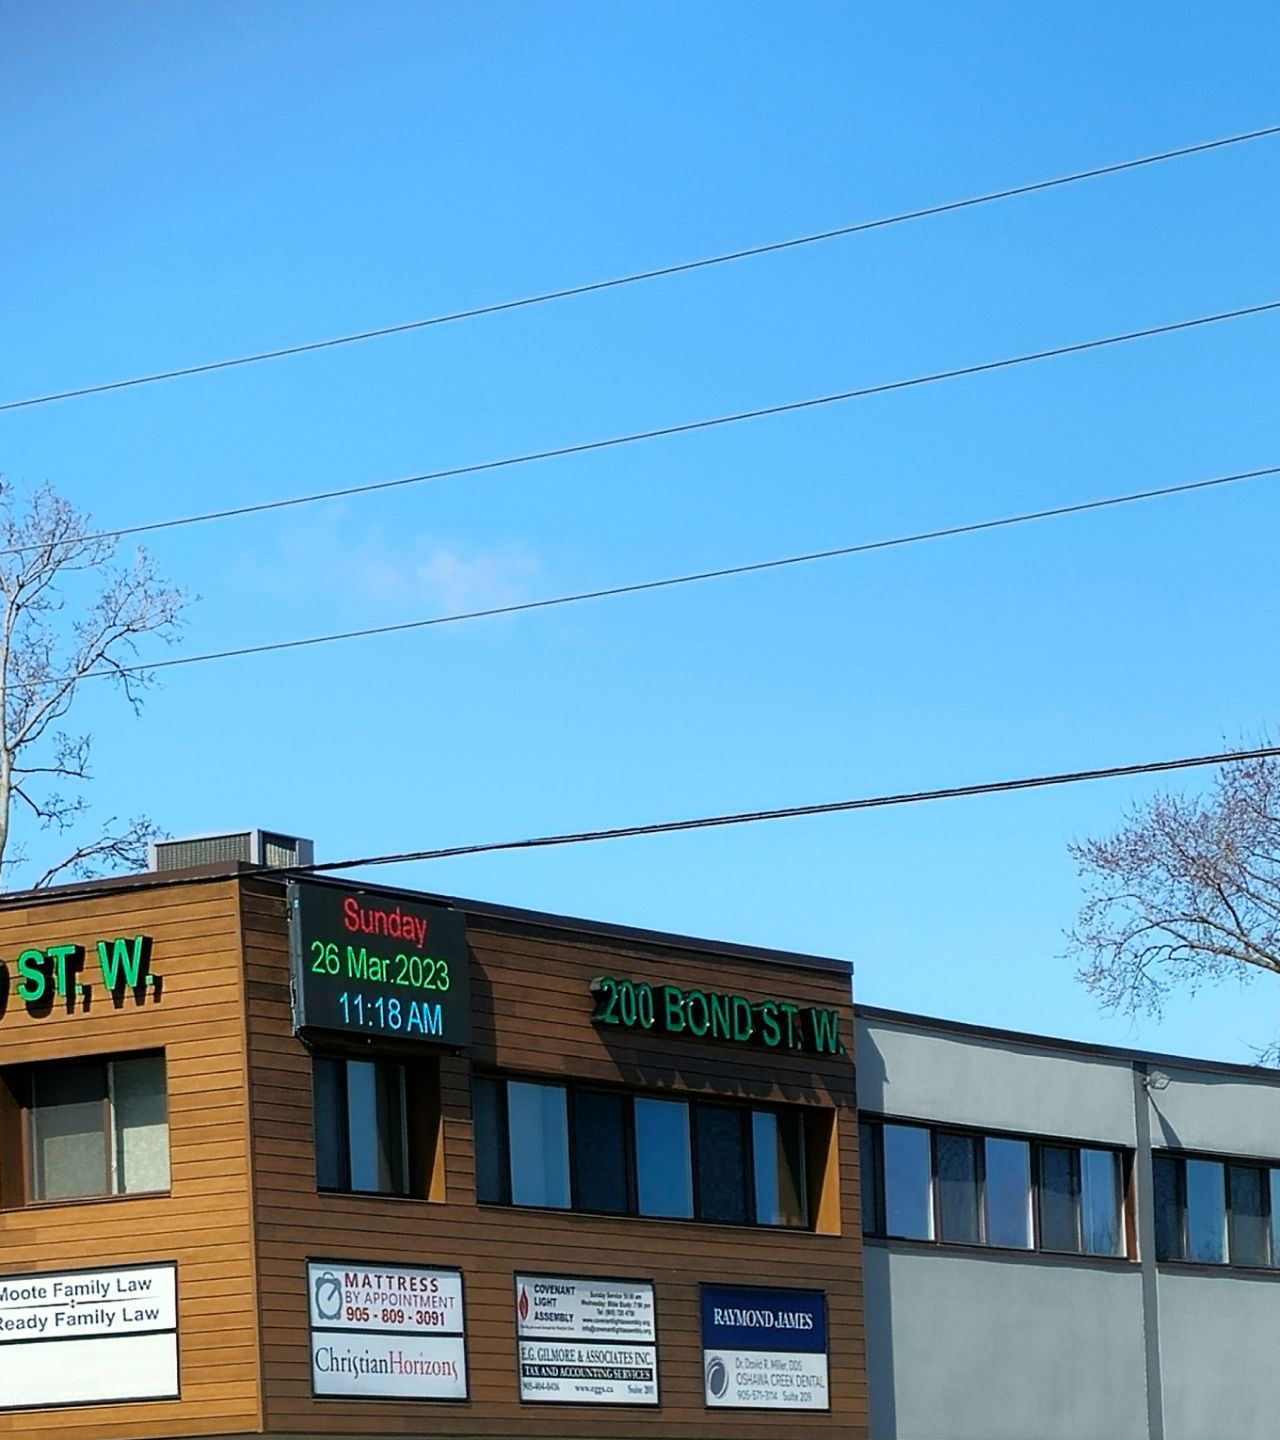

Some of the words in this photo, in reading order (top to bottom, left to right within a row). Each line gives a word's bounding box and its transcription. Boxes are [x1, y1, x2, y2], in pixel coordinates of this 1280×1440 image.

[344, 898, 427, 948] Sunday
[17, 944, 83, 1001] ST.
[97, 935, 154, 990] W.
[311, 940, 340, 974] 26
[347, 946, 450, 991] Mar.2023
[339, 992, 402, 1029] 11:18
[407, 1001, 443, 1036] AM
[598, 976, 654, 1029] 200
[663, 984, 752, 1042] BOND
[762, 1000, 801, 1050] ST.
[812, 1006, 844, 1054] W.
[53, 1280, 110, 1298] Family
[117, 1278, 152, 1293] Law
[344, 1272, 439, 1293] MATTRESS
[534, 1283, 576, 1296] COVENANT
[345, 1290, 361, 1304] BY
[365, 1292, 456, 1309] APPOINTMENT
[534, 1297, 557, 1307] LIGHT
[55, 1309, 115, 1327] Family
[122, 1307, 160, 1322] Law
[346, 1307, 370, 1322] 905
[382, 1308, 404, 1324] 809
[416, 1310, 445, 1326] 3091
[534, 1311, 574, 1323] ASSEMBLY
[714, 1307, 774, 1328] RAYMOND
[775, 1311, 813, 1330] JAMES
[521, 1347, 536, 1361] E.G.
[537, 1348, 576, 1362] GILMORE
[577, 1351, 584, 1362] &
[586, 1350, 633, 1364] ASSOCIATES
[634, 1352, 654, 1365] INC.
[788, 1360, 803, 1371] DDS
[525, 1365, 539, 1376] TAX
[541, 1366, 559, 1376] AND
[560, 1366, 613, 1378] ACCOUNTING
[614, 1368, 650, 1379] SERVICES
[736, 1373, 769, 1386] OSHAWA
[770, 1374, 794, 1387] CREEK
[796, 1374, 825, 1388] DENTAL
